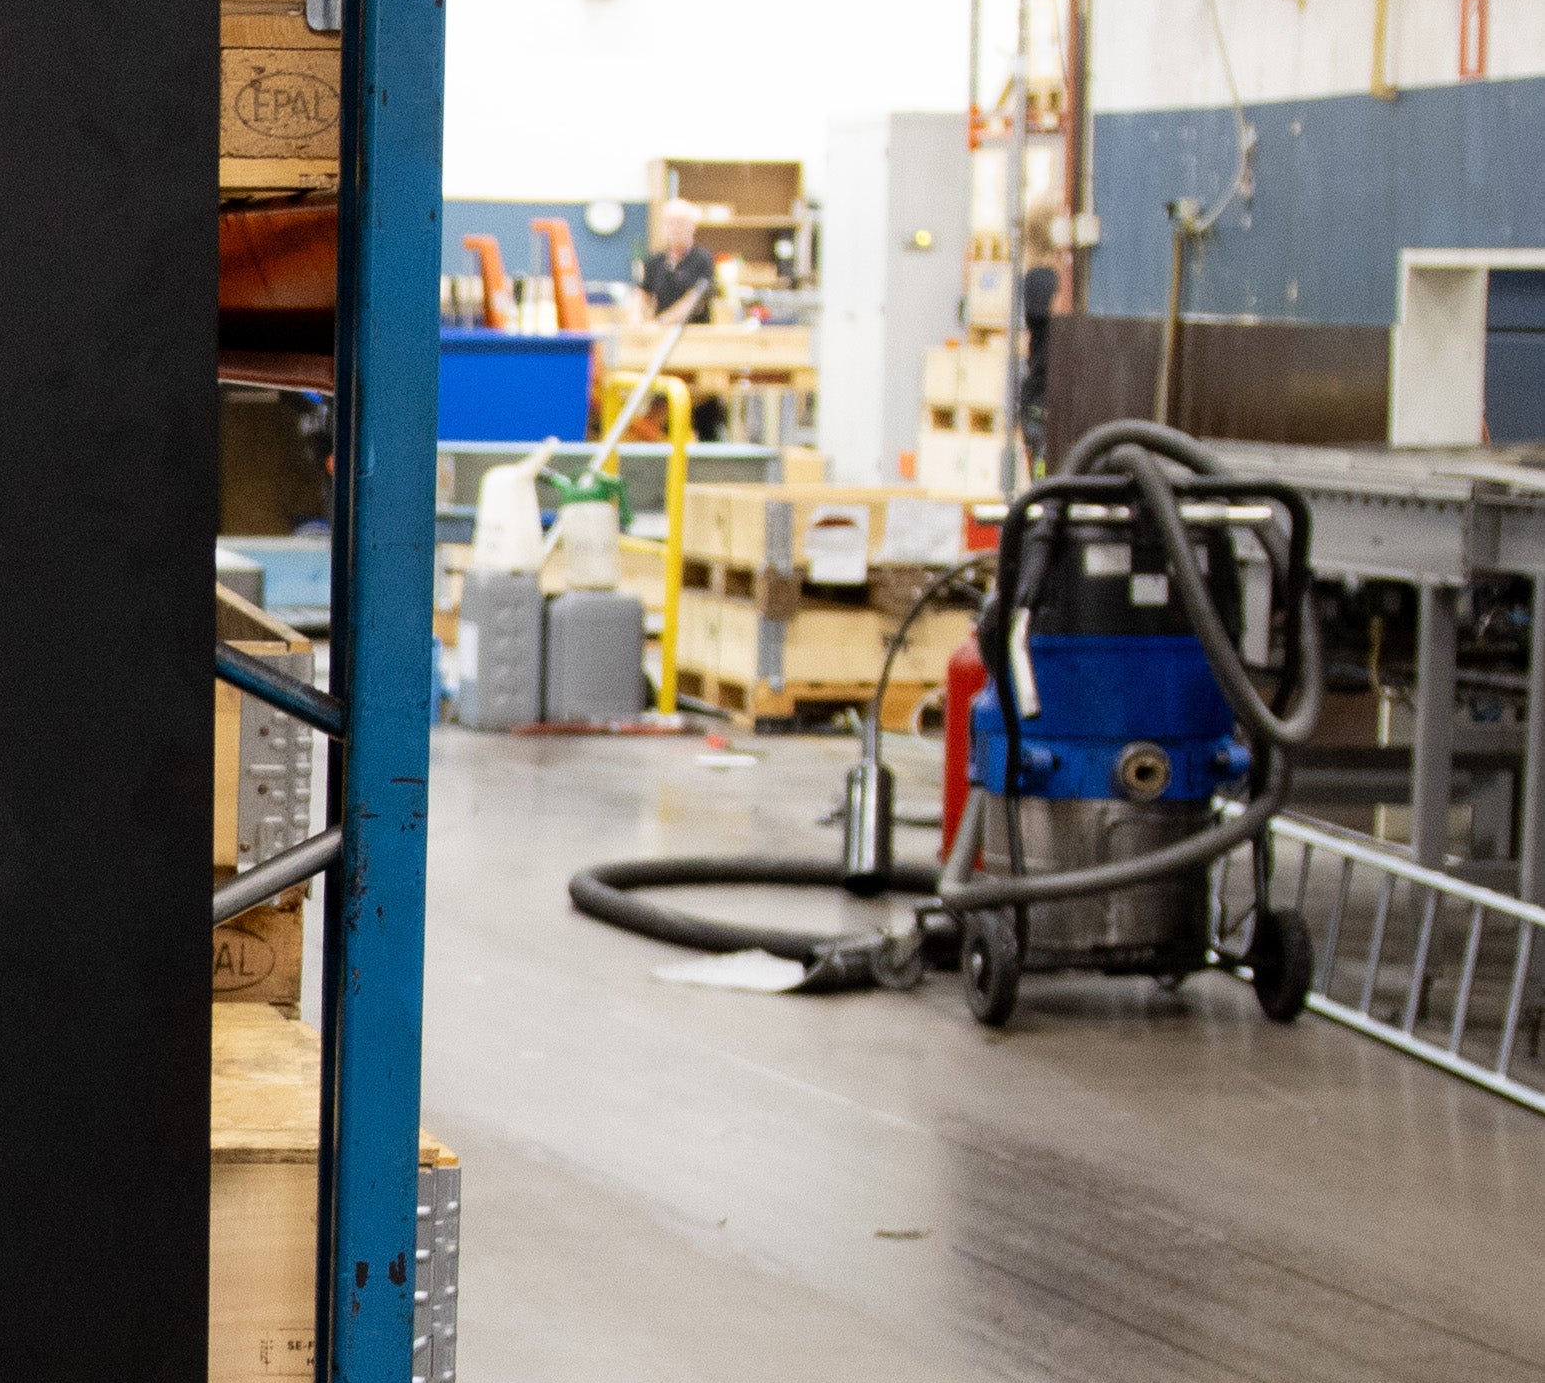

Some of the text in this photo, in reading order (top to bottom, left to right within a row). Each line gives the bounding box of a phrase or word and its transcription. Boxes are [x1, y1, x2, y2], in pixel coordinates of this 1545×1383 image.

[253, 88, 328, 123] EPAL
[213, 942, 255, 977] AL
[287, 1340, 314, 1351] SE-F
